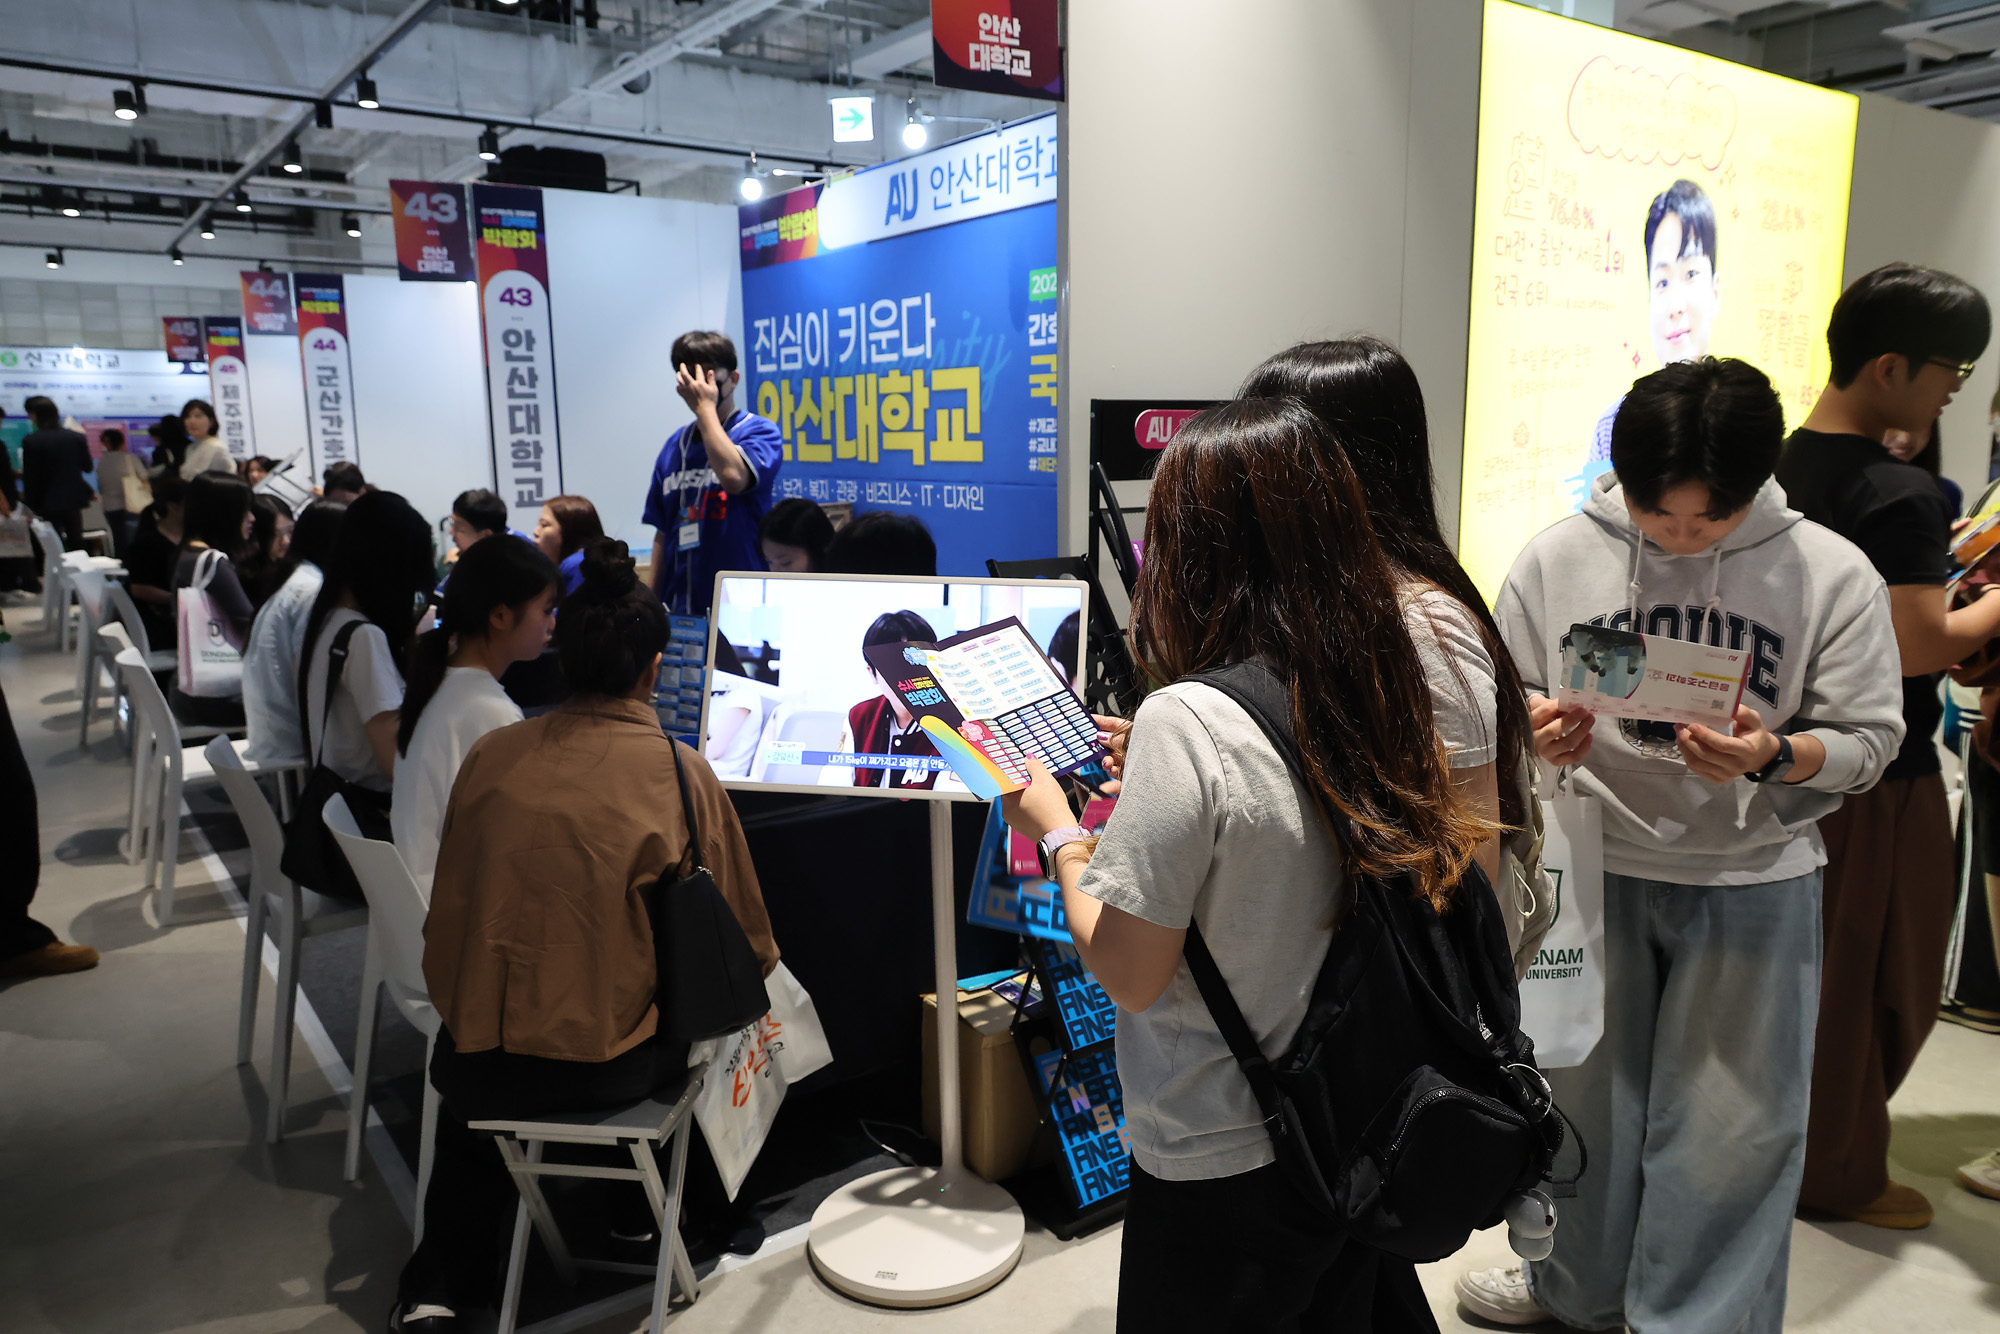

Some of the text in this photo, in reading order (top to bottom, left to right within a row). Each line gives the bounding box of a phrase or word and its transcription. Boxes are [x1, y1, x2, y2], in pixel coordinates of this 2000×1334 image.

[978, 13, 1021, 46] 안산
[969, 43, 1031, 77] 대학교
[404, 192, 458, 224] 43
[885, 168, 918, 226] AU
[482, 227, 537, 250] 박람회
[778, 208, 818, 243] 박람회
[417, 259, 456, 274] 대학교
[422, 246, 448, 261] 안산
[249, 278, 287, 299] 44
[499, 287, 533, 307] 43
[1493, 274, 1519, 308] 전국
[313, 338, 337, 351] 44
[754, 308, 829, 373] 진심이
[838, 292, 936, 365] 키운다
[316, 365, 346, 469] 군산간호
[502, 328, 544, 508] 안산대학교
[757, 366, 984, 466] 안산대학교
[1145, 416, 1173, 443] AU
[782, 478, 802, 499] 보건
[808, 479, 829, 501] 복지
[836, 479, 857, 503] 관광
[865, 481, 912, 506] 비즈니스
[921, 484, 934, 506] IT
[943, 485, 984, 511] 디자인
[897, 679, 917, 692] 수시
[1666, 672, 1730, 692] 응급구조학과
[904, 687, 947, 707] 박람회
[828, 754, 844, 764] 내가
[899, 757, 919, 769] 요즘은
[920, 758, 929, 769] 잘
[1525, 966, 1583, 980] UNIVERSITY
[1067, 1005, 1116, 1048] ANS
